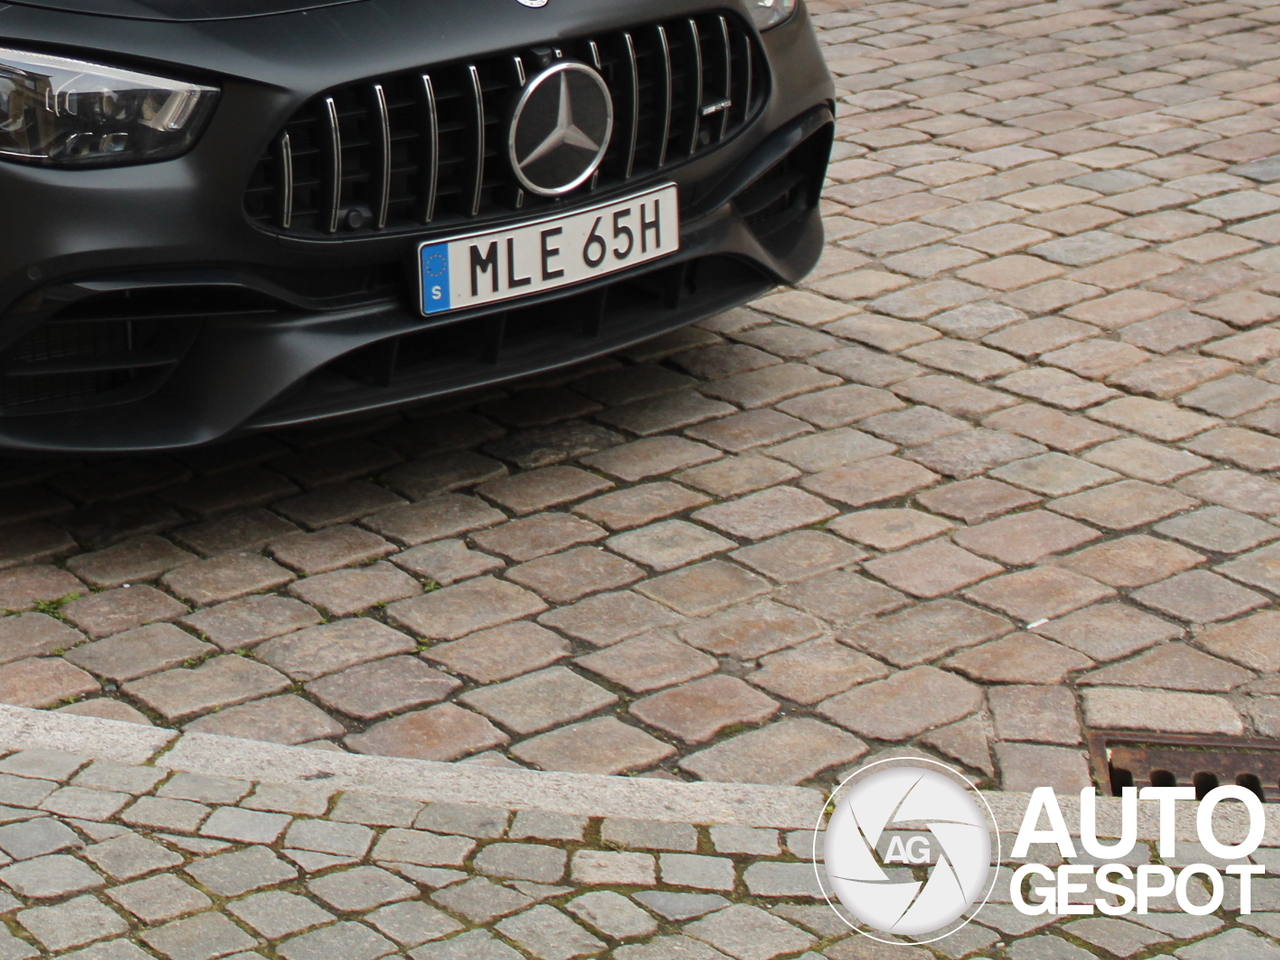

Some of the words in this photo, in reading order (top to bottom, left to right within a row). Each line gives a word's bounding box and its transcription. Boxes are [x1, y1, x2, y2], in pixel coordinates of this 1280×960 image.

[469, 226, 565, 297] MLE
[582, 198, 662, 269] 65H
[431, 285, 442, 300] S
